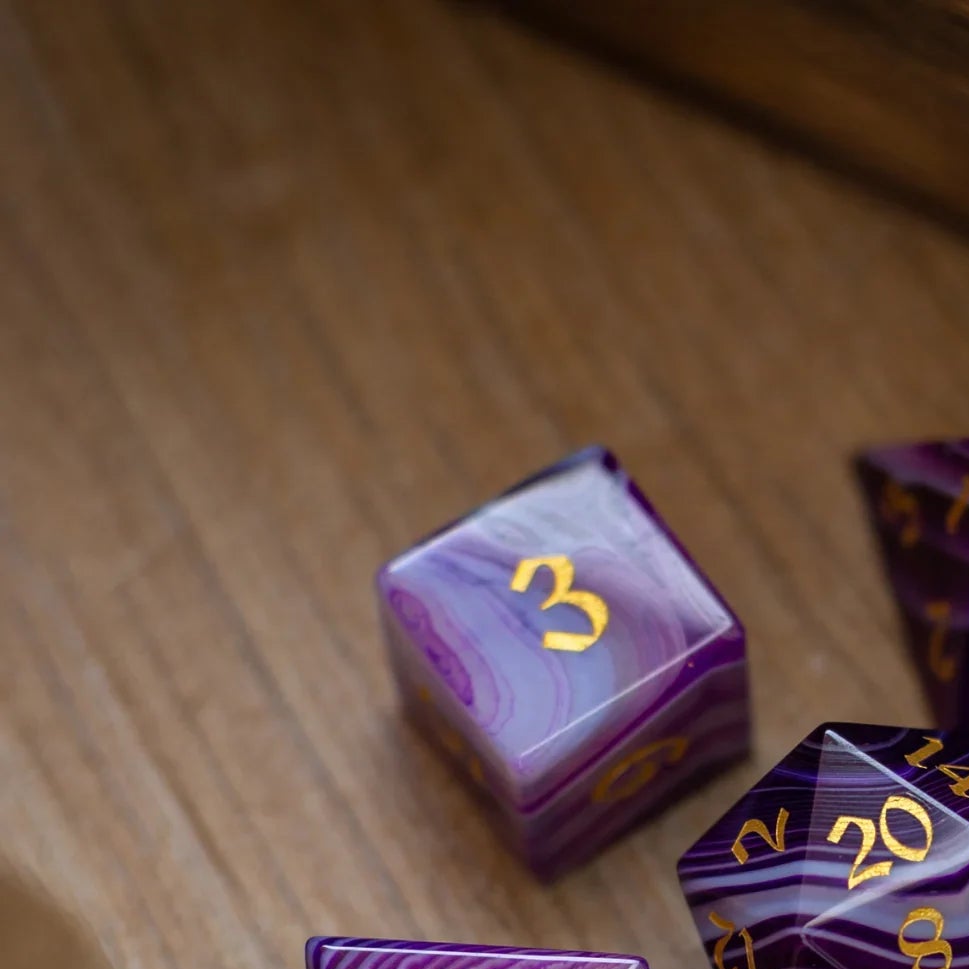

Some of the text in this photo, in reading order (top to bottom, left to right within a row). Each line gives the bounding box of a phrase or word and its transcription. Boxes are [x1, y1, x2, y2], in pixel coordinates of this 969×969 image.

[510, 556, 609, 652] 3
[730, 807, 790, 865] 2
[826, 795, 934, 891] 20
